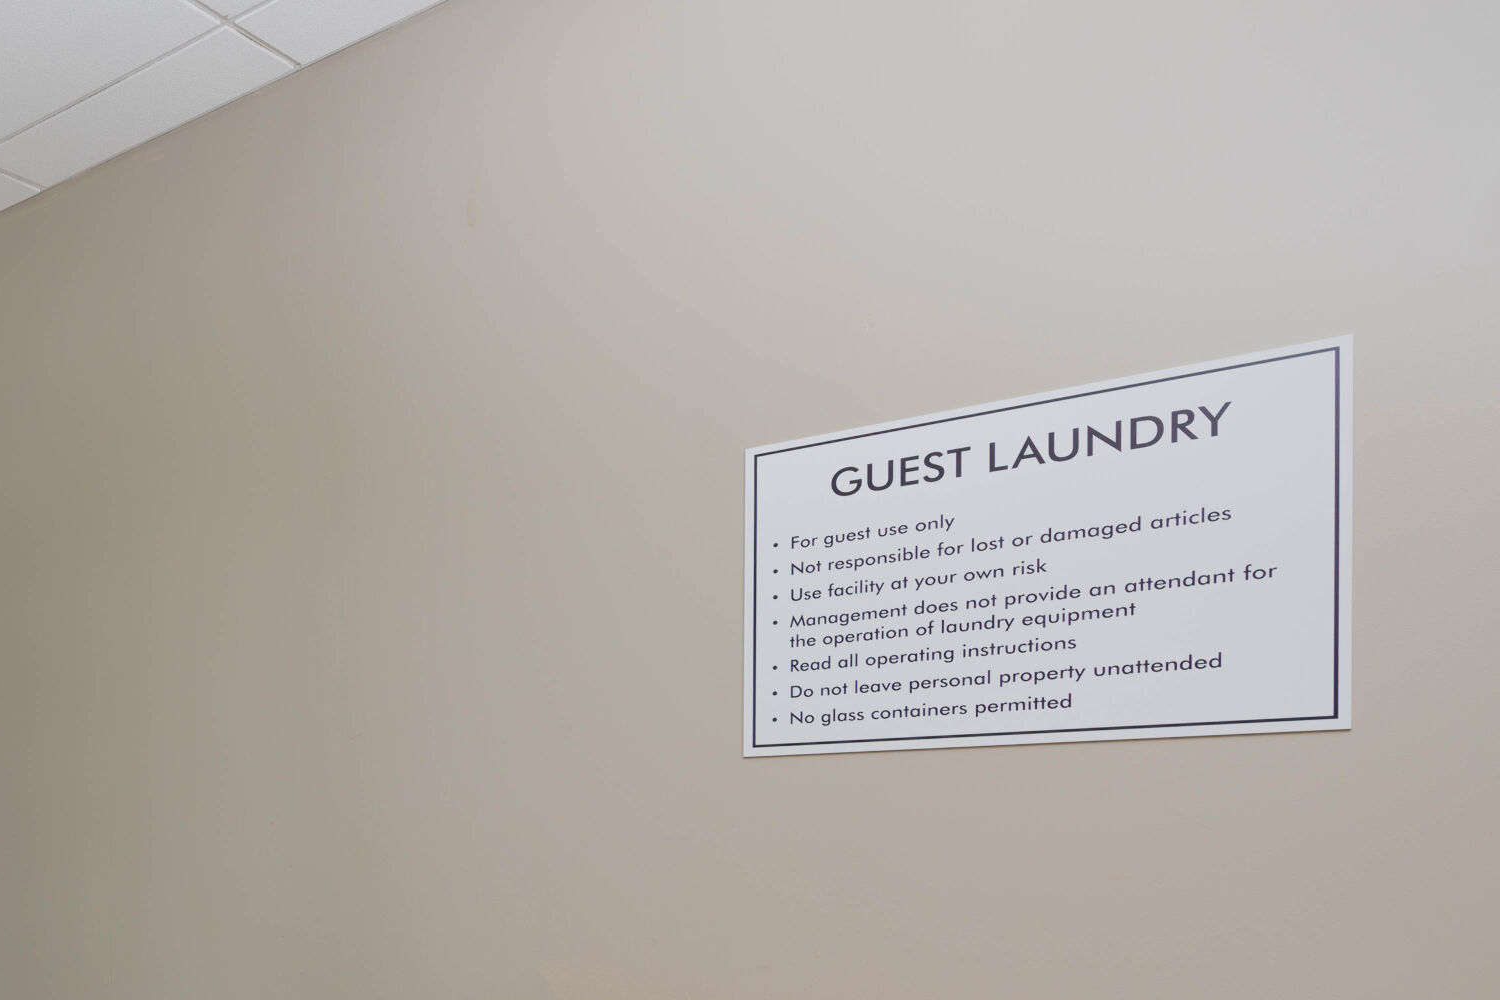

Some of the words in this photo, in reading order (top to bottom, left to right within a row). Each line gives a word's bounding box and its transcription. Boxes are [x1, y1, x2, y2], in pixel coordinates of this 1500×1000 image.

[831, 446, 971, 497] GUEST
[989, 401, 1232, 473] LAUNDRY
[791, 535, 818, 549] For
[824, 527, 871, 548] guest
[878, 524, 908, 537] use
[915, 514, 955, 532] only
[791, 560, 822, 575] Not
[828, 545, 930, 571] responsible
[937, 541, 964, 557] for
[971, 536, 1004, 552] lost
[1012, 535, 1033, 547] or
[1040, 515, 1141, 544] damaged
[1150, 507, 1232, 529] articles
[790, 604, 907, 628] Management
[914, 600, 958, 615] does
[966, 594, 997, 610] not
[1005, 584, 1081, 609] provide
[1089, 584, 1115, 597] an
[1124, 568, 1235, 593] attendant
[1243, 564, 1277, 581] for
[791, 588, 822, 602] Use
[827, 579, 885, 597] facility
[891, 576, 908, 590] at
[914, 573, 957, 591] your
[964, 568, 1004, 582] own
[1013, 558, 1047, 576] risk
[790, 634, 816, 648] the
[822, 626, 908, 648] operation
[916, 620, 935, 636] of
[941, 614, 1015, 634] laundry
[1022, 602, 1136, 628] equipment
[790, 655, 831, 672] Read
[838, 653, 858, 668] all
[865, 647, 954, 669] operating
[962, 637, 1077, 658] instructions
[790, 685, 814, 698] Do
[821, 683, 848, 696] not
[855, 680, 902, 694] leave
[909, 669, 991, 694] personal
[1000, 665, 1086, 687] property
[1094, 651, 1222, 677] unattended
[790, 711, 815, 725] No
[821, 708, 864, 726] glass
[871, 703, 967, 720] containers
[975, 692, 1072, 718] permitted
